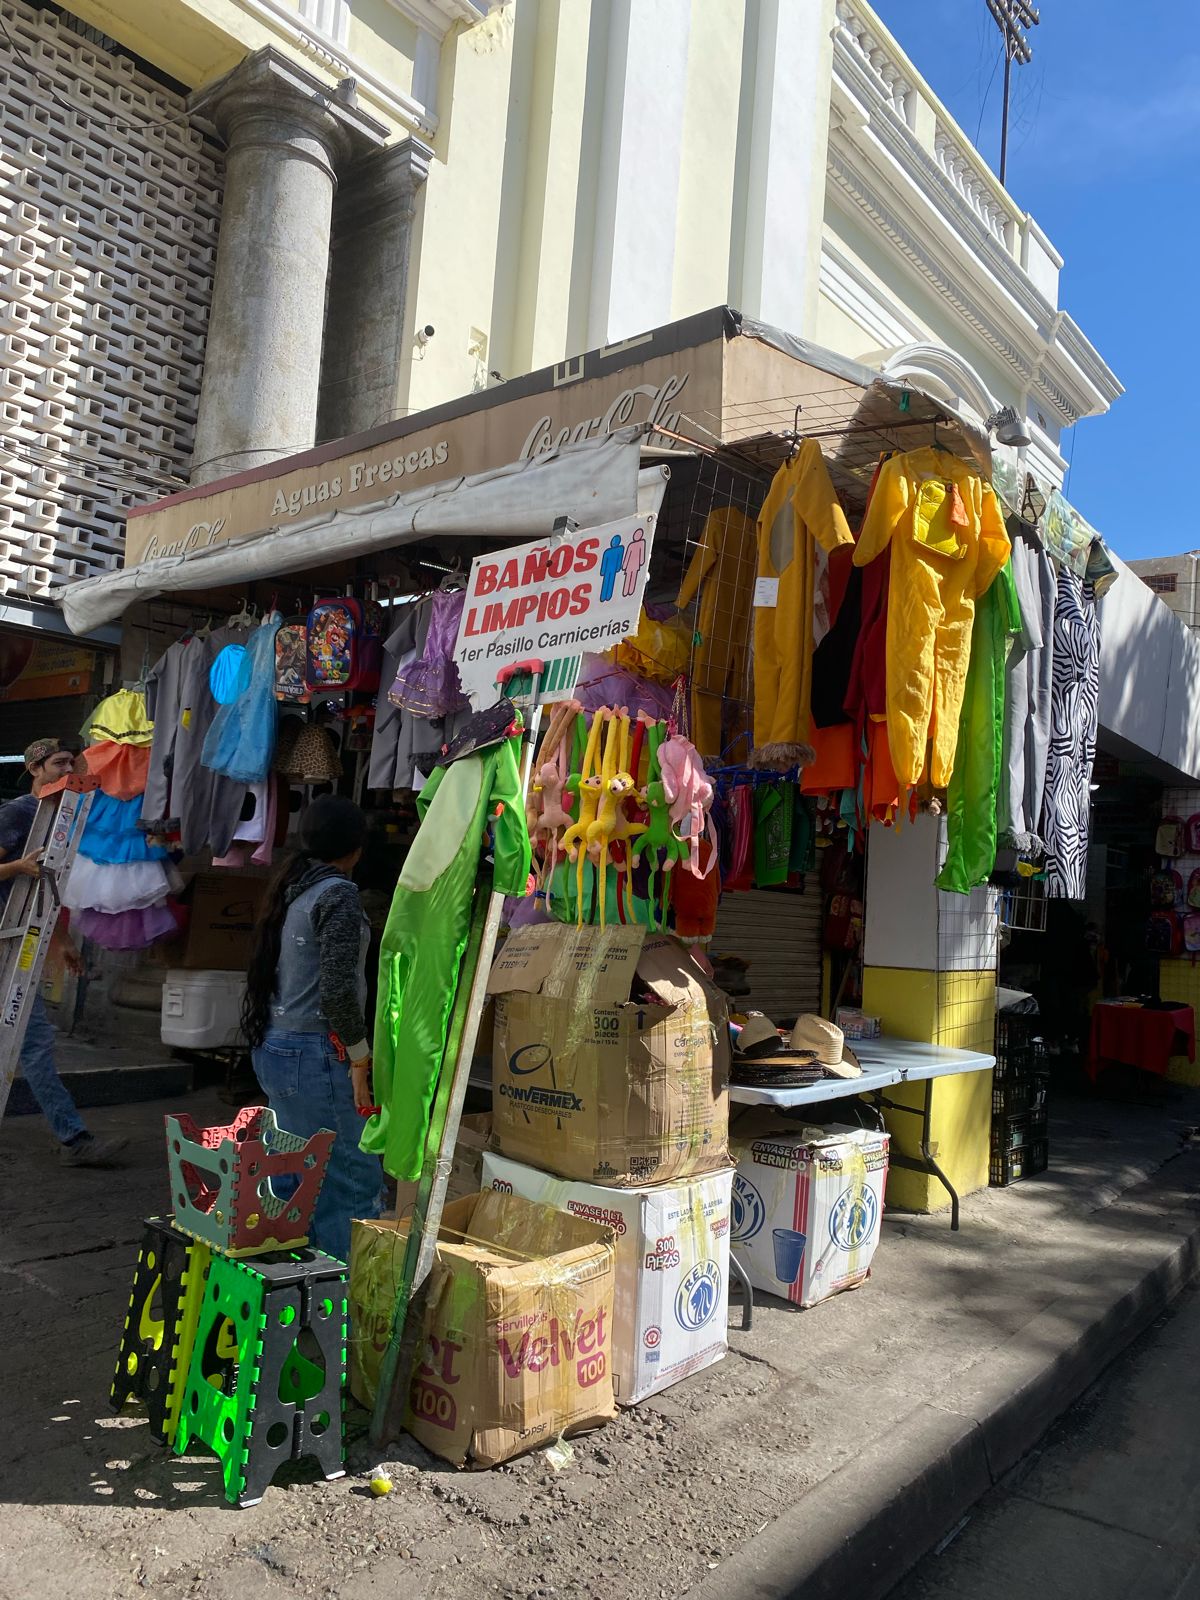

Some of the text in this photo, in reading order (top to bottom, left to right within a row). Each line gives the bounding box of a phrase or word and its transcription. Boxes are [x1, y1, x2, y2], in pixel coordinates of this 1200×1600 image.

[271, 440, 449, 517] Aguas Frescas
[473, 537, 600, 598] BAÑOS
[463, 582, 593, 638] LIMPIOS
[460, 619, 630, 663] 1er Pasillo Carnicerías
[593, 1008, 620, 1017] Content:
[593, 1017, 619, 1031] 300
[594, 1030, 619, 1039] pieces
[499, 1084, 583, 1111] CONVERMEX
[753, 1142, 791, 1158] ENVASE
[753, 1153, 807, 1172] TERMICO
[568, 1201, 602, 1217] ENVASE
[601, 1210, 609, 1219] 1
[656, 1236, 675, 1253] 300
[646, 1250, 680, 1271] PIEZAS
[495, 1305, 607, 1379] Velvet
[581, 1355, 604, 1383] 100
[414, 1386, 450, 1417] 100
[531, 1422, 548, 1436] PSF
